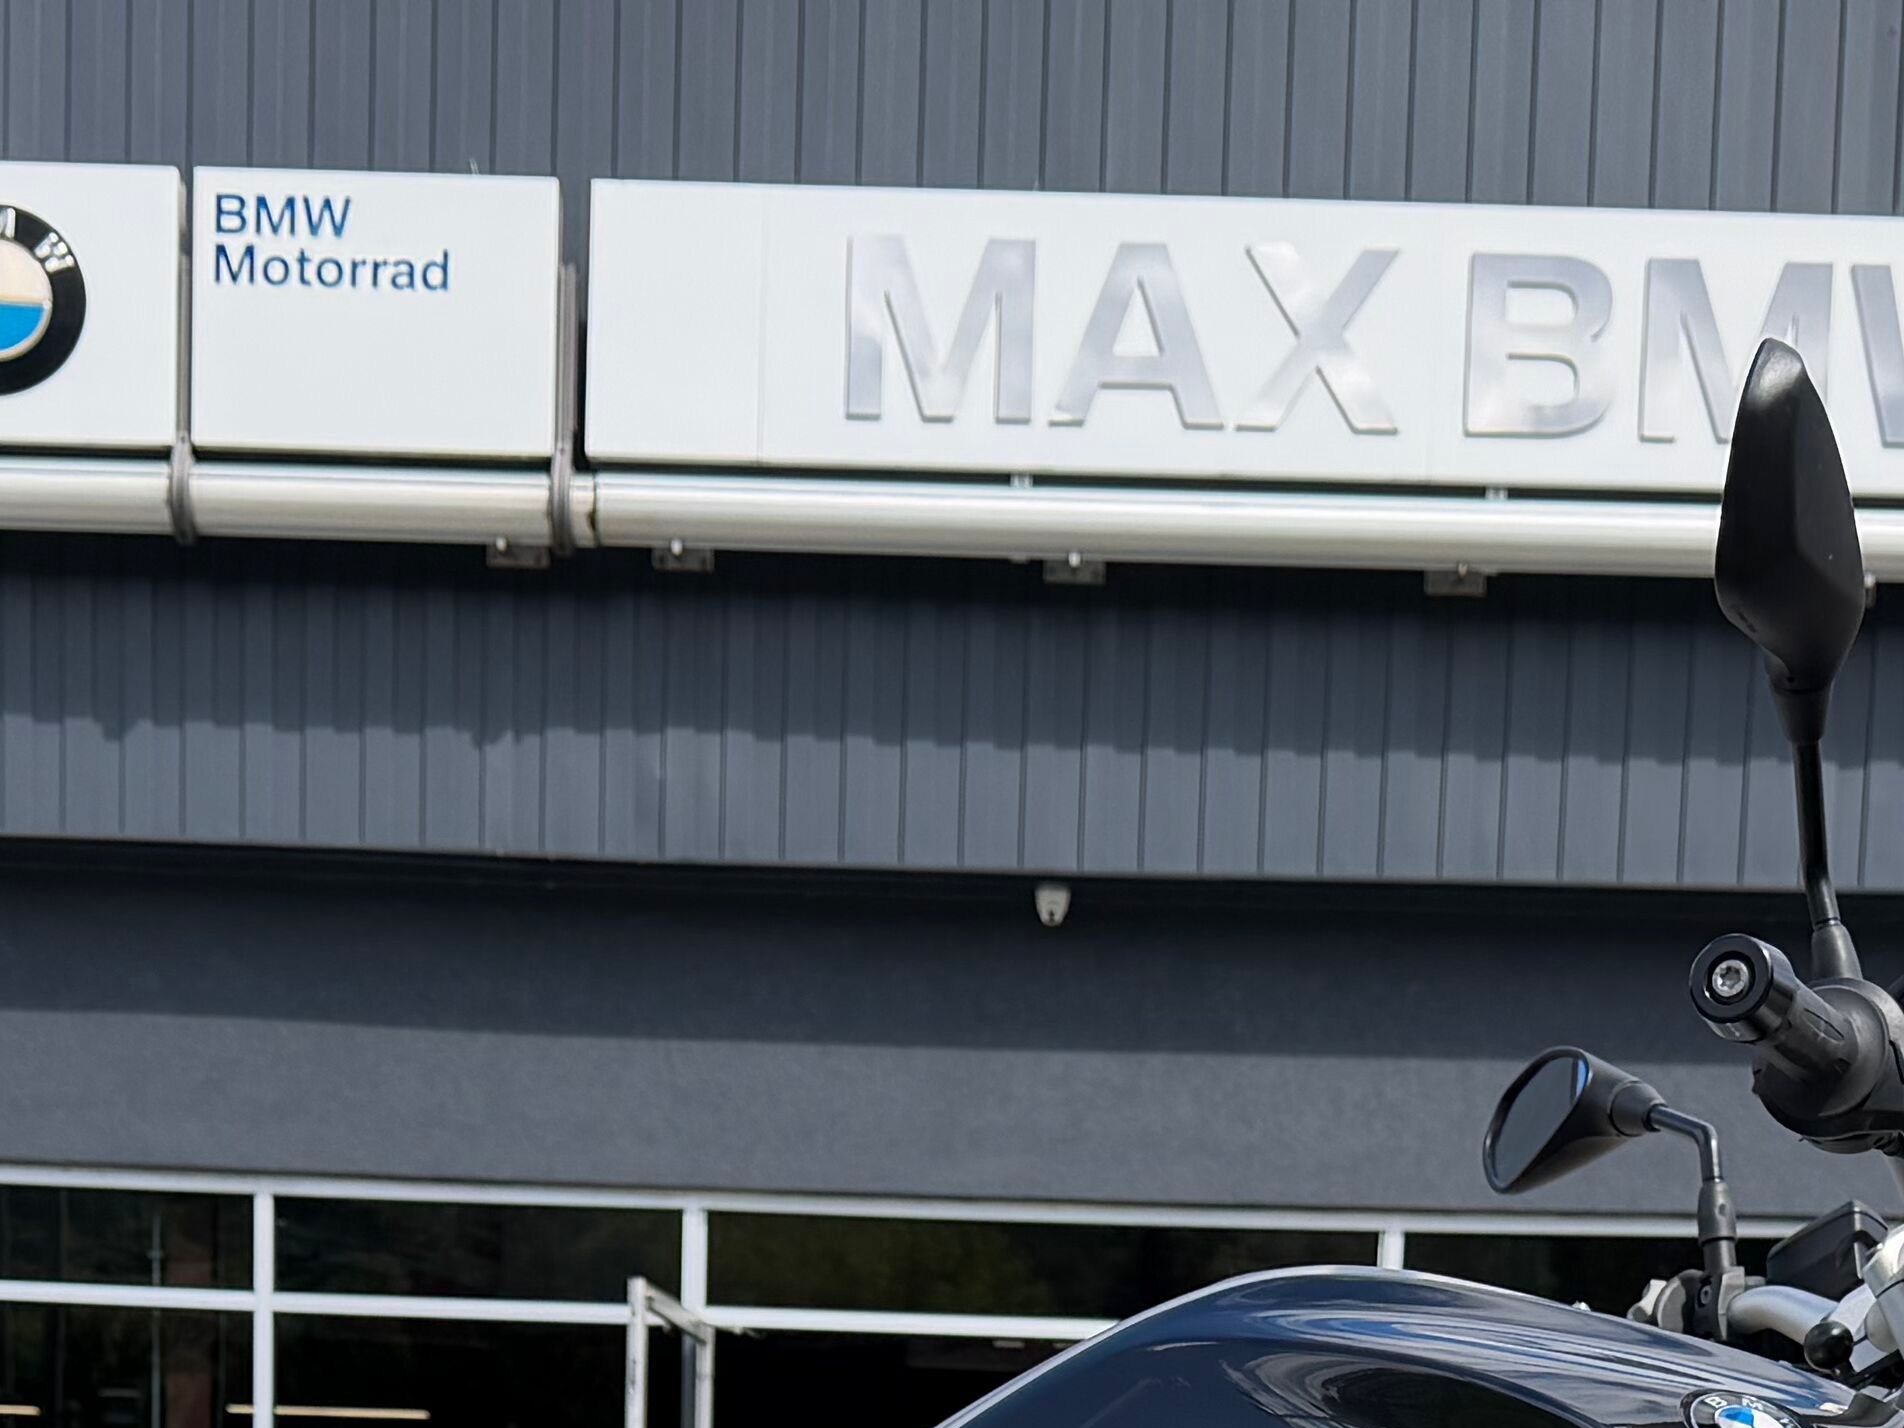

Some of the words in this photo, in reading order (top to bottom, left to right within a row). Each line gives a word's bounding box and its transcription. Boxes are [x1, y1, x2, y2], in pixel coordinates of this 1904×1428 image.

[213, 192, 352, 237] BMW
[213, 244, 450, 292] Motorrad
[844, 234, 1401, 436] MAX
